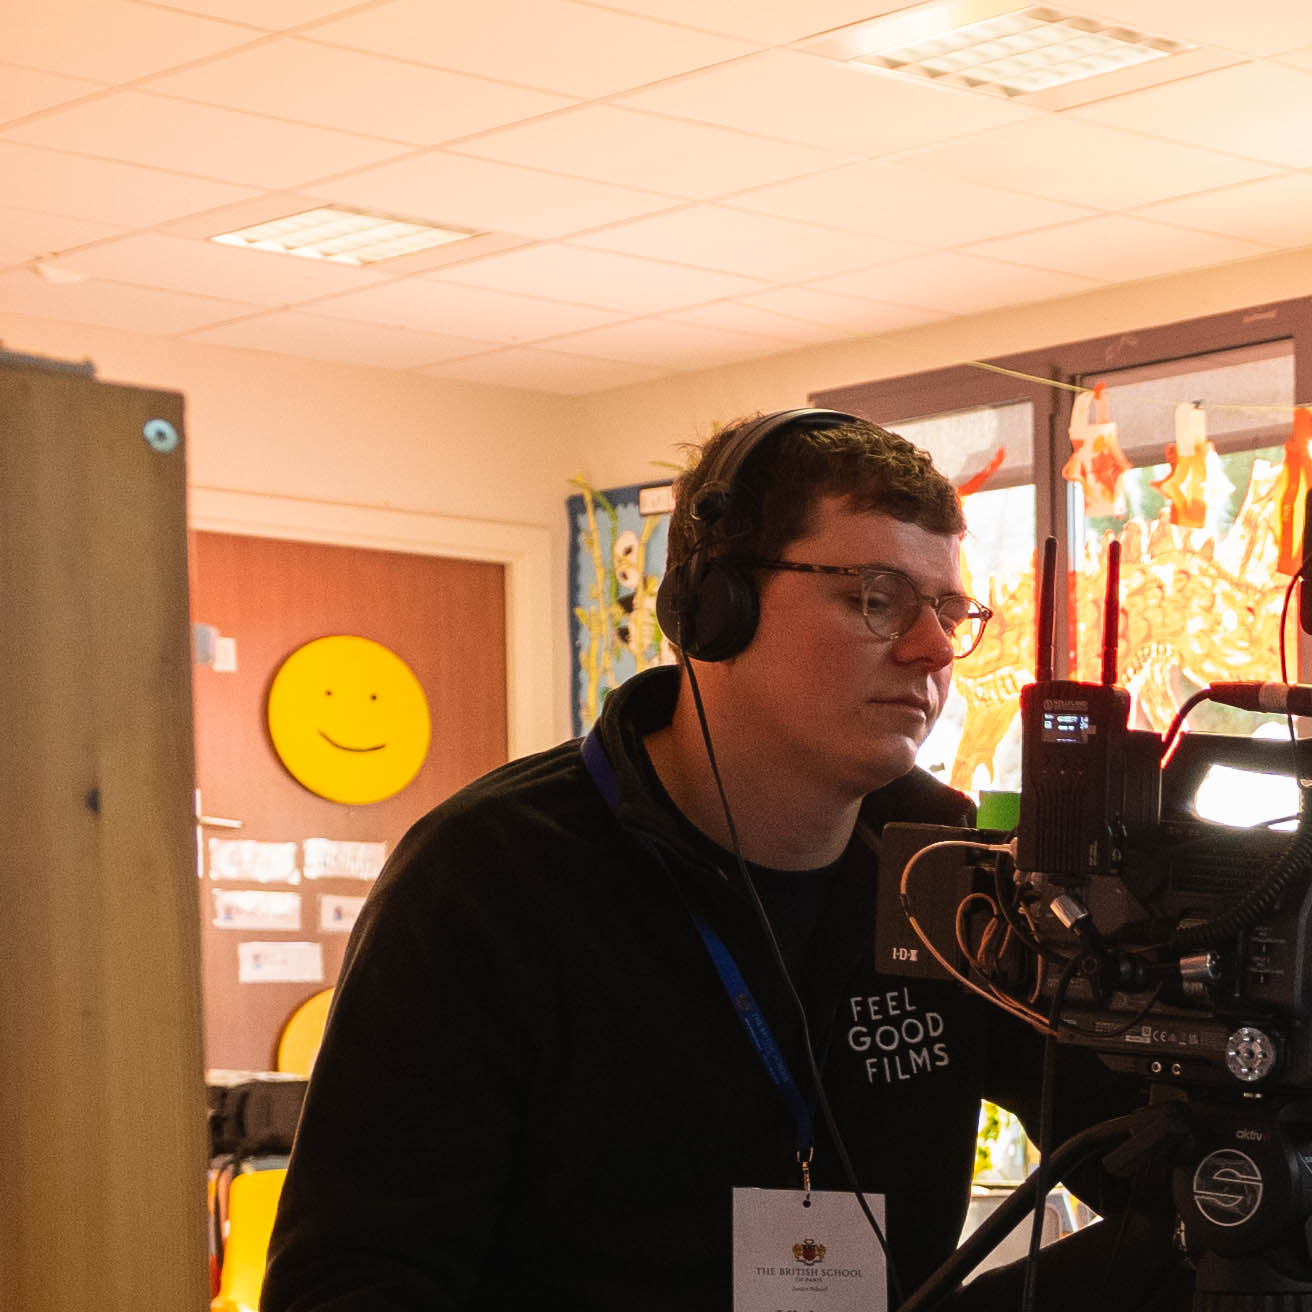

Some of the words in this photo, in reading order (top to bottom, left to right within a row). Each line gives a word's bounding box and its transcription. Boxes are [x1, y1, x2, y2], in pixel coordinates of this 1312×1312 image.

[850, 987, 917, 1022] FEEL
[848, 1012, 944, 1051] GOOD
[866, 1043, 950, 1083] FILMS
[757, 1267, 776, 1276] THE
[779, 1267, 819, 1277] BRITISH
[822, 1268, 863, 1278] SCHOOL
